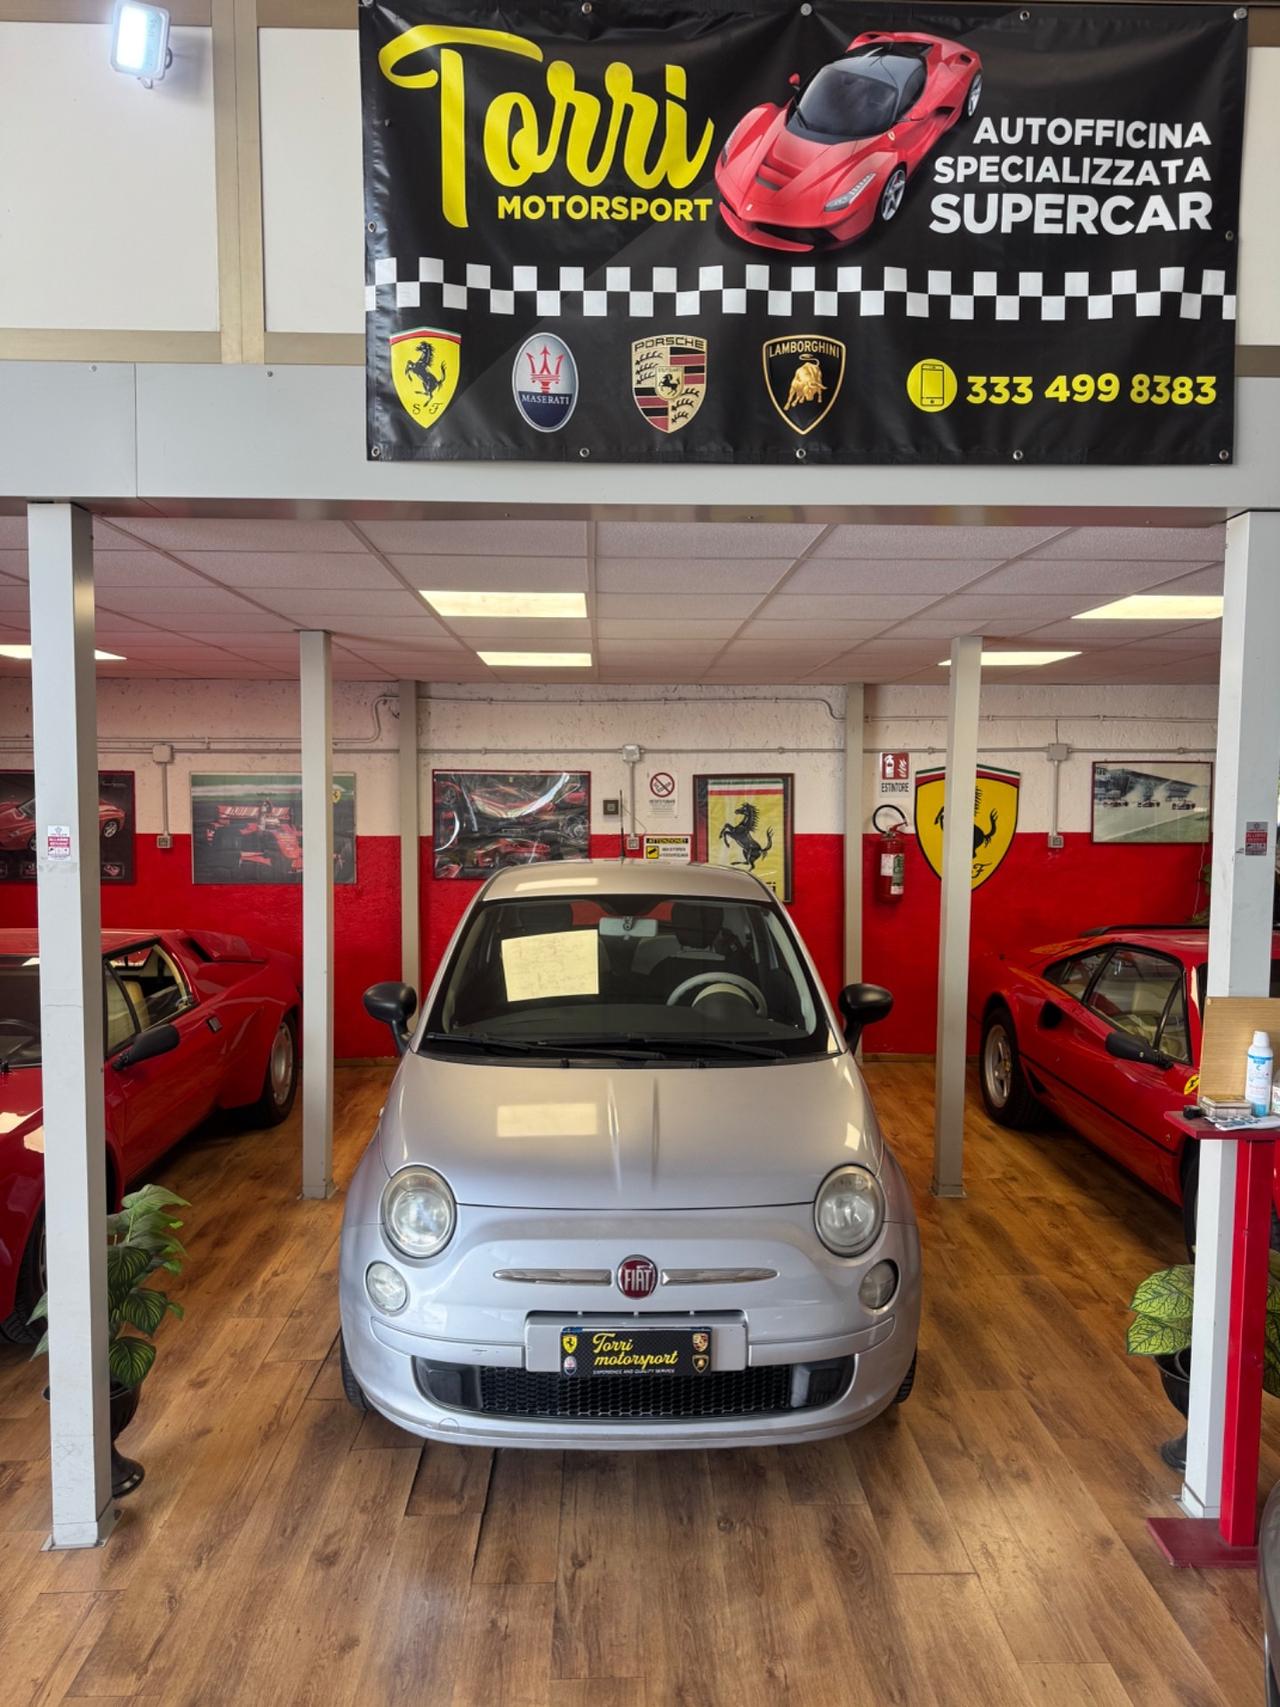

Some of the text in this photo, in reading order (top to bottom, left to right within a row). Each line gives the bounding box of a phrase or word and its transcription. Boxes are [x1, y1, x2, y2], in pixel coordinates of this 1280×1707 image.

[378, 24, 715, 229] Torri
[972, 116, 1212, 149] AUTOFFICINA
[933, 155, 1212, 186] SPECIALIZZATA
[497, 194, 713, 222] MOTORSPORT
[928, 191, 1213, 236] SUPERCAR
[634, 336, 705, 352] PORSCHE
[769, 340, 840, 359] LAMBORGHINI
[521, 394, 570, 405] MASERATI
[966, 372, 1217, 405] 333 499 8383
[881, 782, 910, 793] ESTINTORE
[624, 1269, 652, 1291] FIAT
[592, 1332, 634, 1353] Torri
[594, 1350, 679, 1373] motorsport
